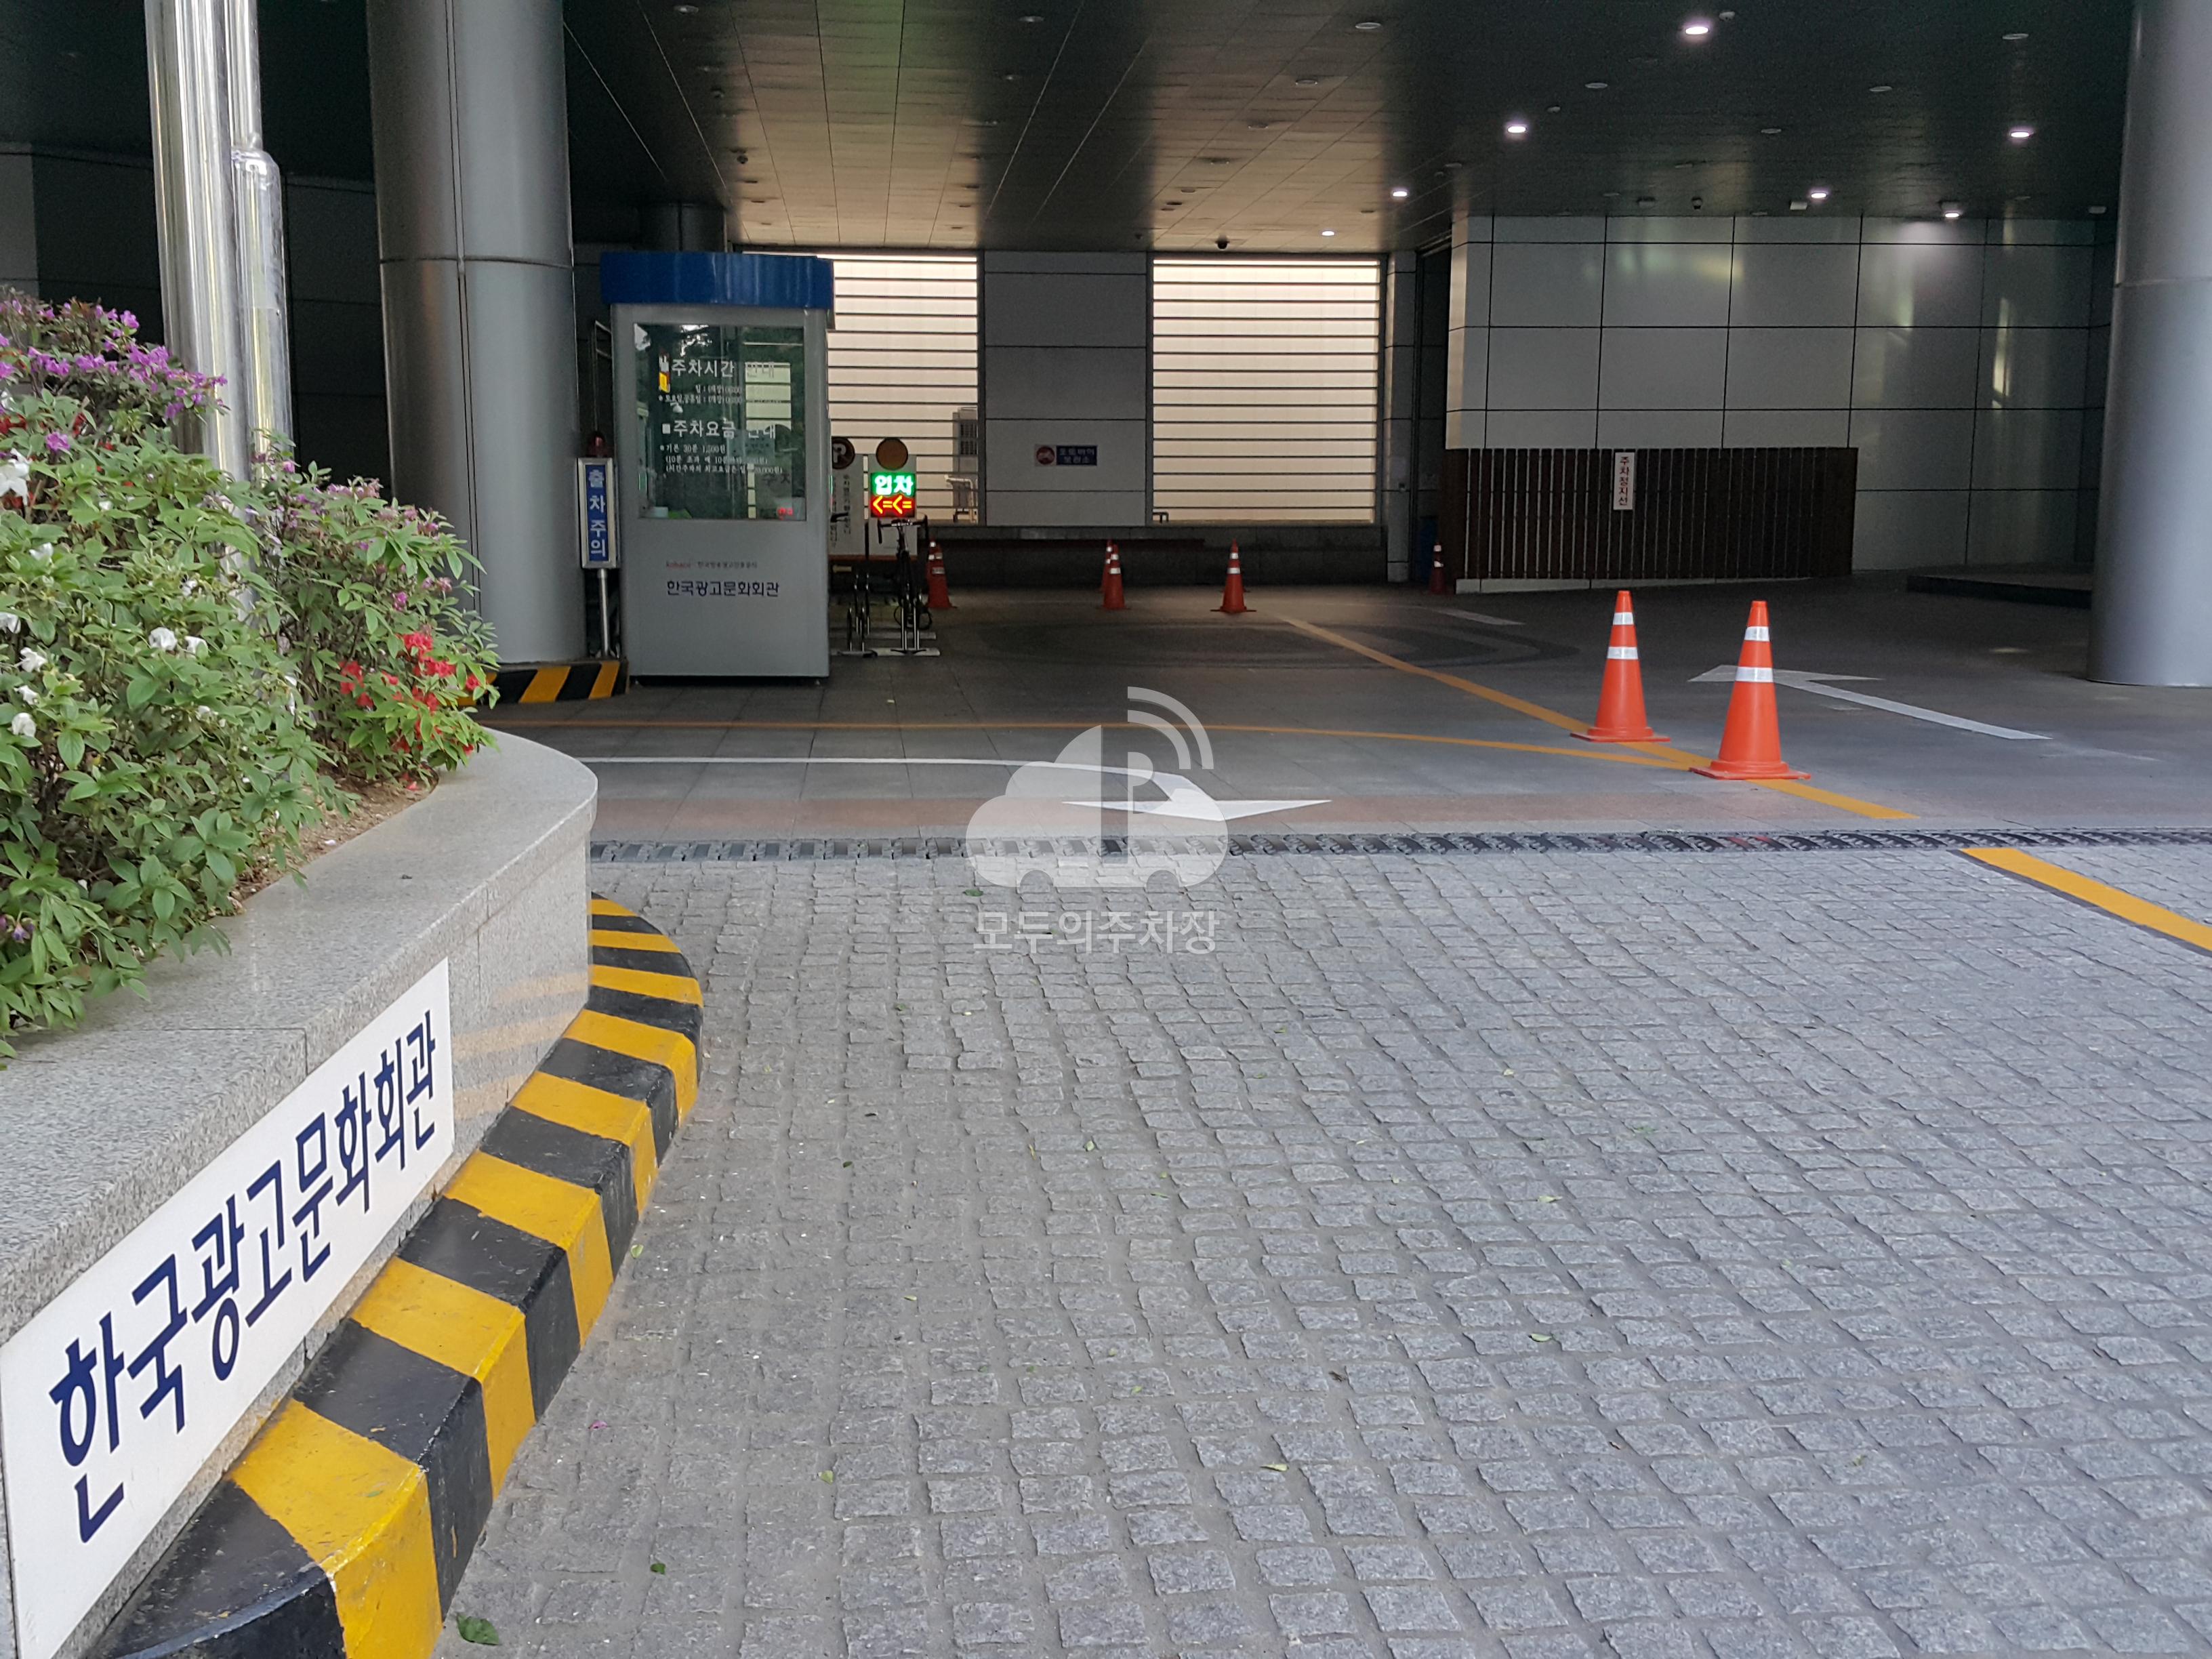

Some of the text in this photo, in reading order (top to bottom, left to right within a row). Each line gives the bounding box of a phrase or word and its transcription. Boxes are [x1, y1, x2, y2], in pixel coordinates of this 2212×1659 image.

[672, 359, 735, 377] 주차시간
[674, 420, 735, 439] 주차요금
[874, 475, 913, 495] 입차
[588, 469, 606, 557] 출차주의
[667, 581, 779, 597] 한국광고문화회관
[49, 1010, 437, 1543] 한국광고문화회관
